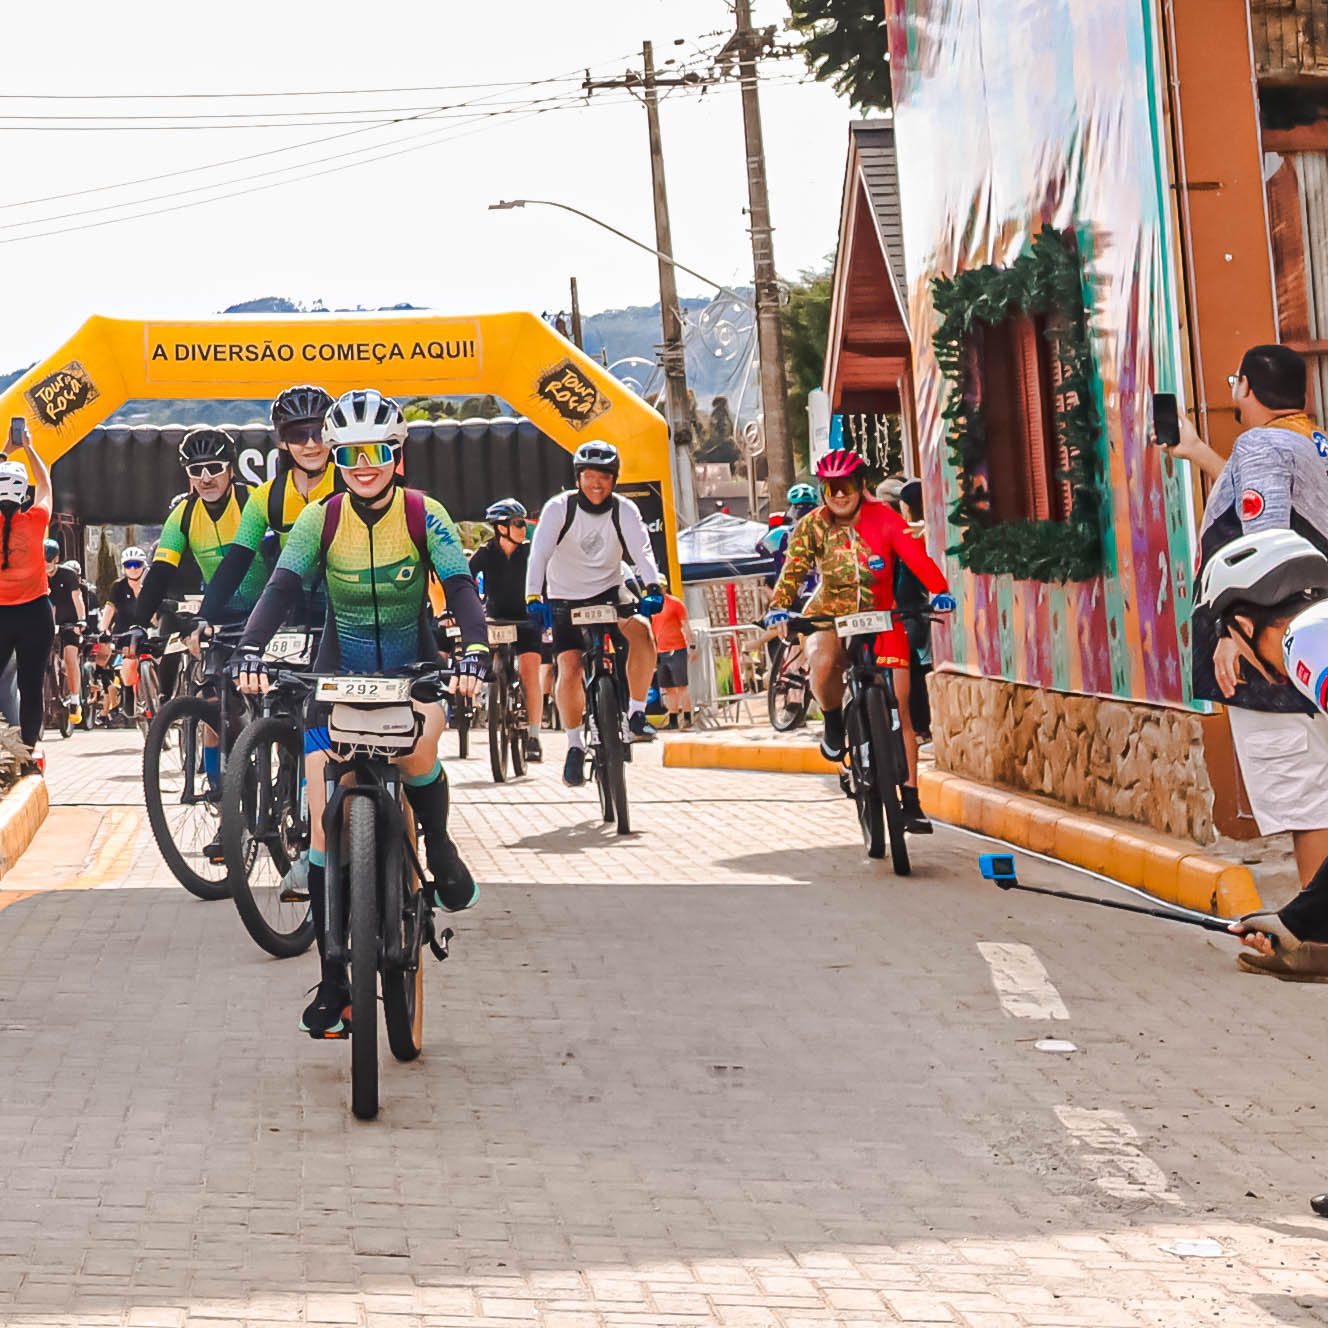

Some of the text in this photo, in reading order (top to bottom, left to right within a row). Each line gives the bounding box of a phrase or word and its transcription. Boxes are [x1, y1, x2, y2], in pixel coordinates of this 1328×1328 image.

[151, 340, 476, 365] A DIVERSÃO COMEÇA AQUI!
[345, 684, 378, 695] 292
